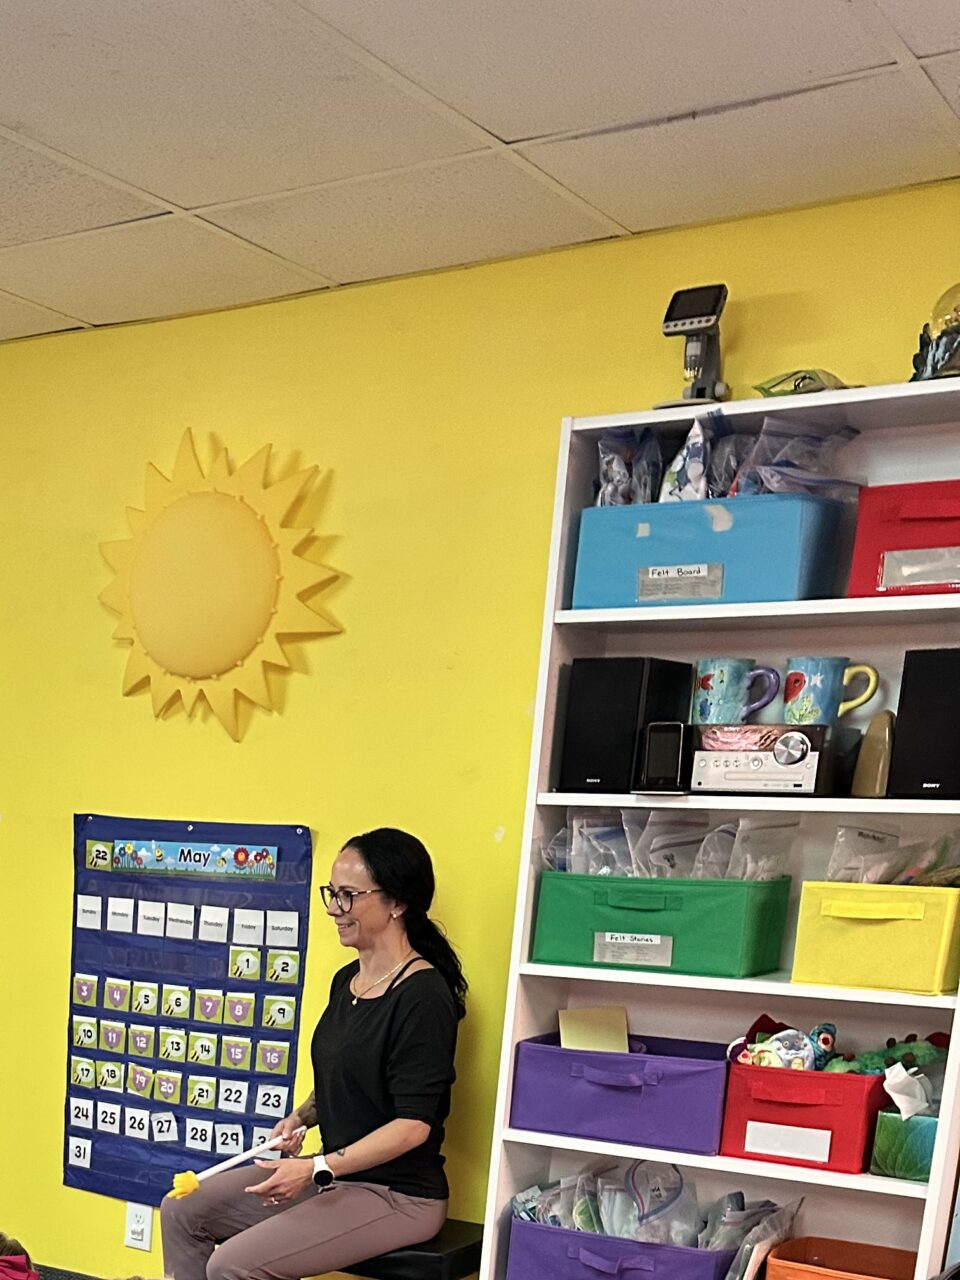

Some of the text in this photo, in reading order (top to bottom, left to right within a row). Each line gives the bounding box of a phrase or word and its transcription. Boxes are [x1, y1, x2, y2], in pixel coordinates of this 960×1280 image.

[676, 566, 702, 577] Board
[95, 847, 212, 867] 22 May
[271, 925, 294, 933] Saturday
[280, 961, 290, 973] 2
[80, 984, 286, 1019] 3 4 5 6 7 8 9
[82, 1028, 279, 1065] 10 11 12 13 14 15 16
[80, 1067, 282, 1109] 17 18 19 20 21 22 23
[73, 1104, 89, 1121] 24
[100, 1110, 116, 1126] 25
[128, 1115, 145, 1132] 26
[156, 1119, 173, 1134] 27
[190, 1126, 208, 1142] 28
[220, 1131, 239, 1147] 29
[73, 1144, 87, 1159] 31
